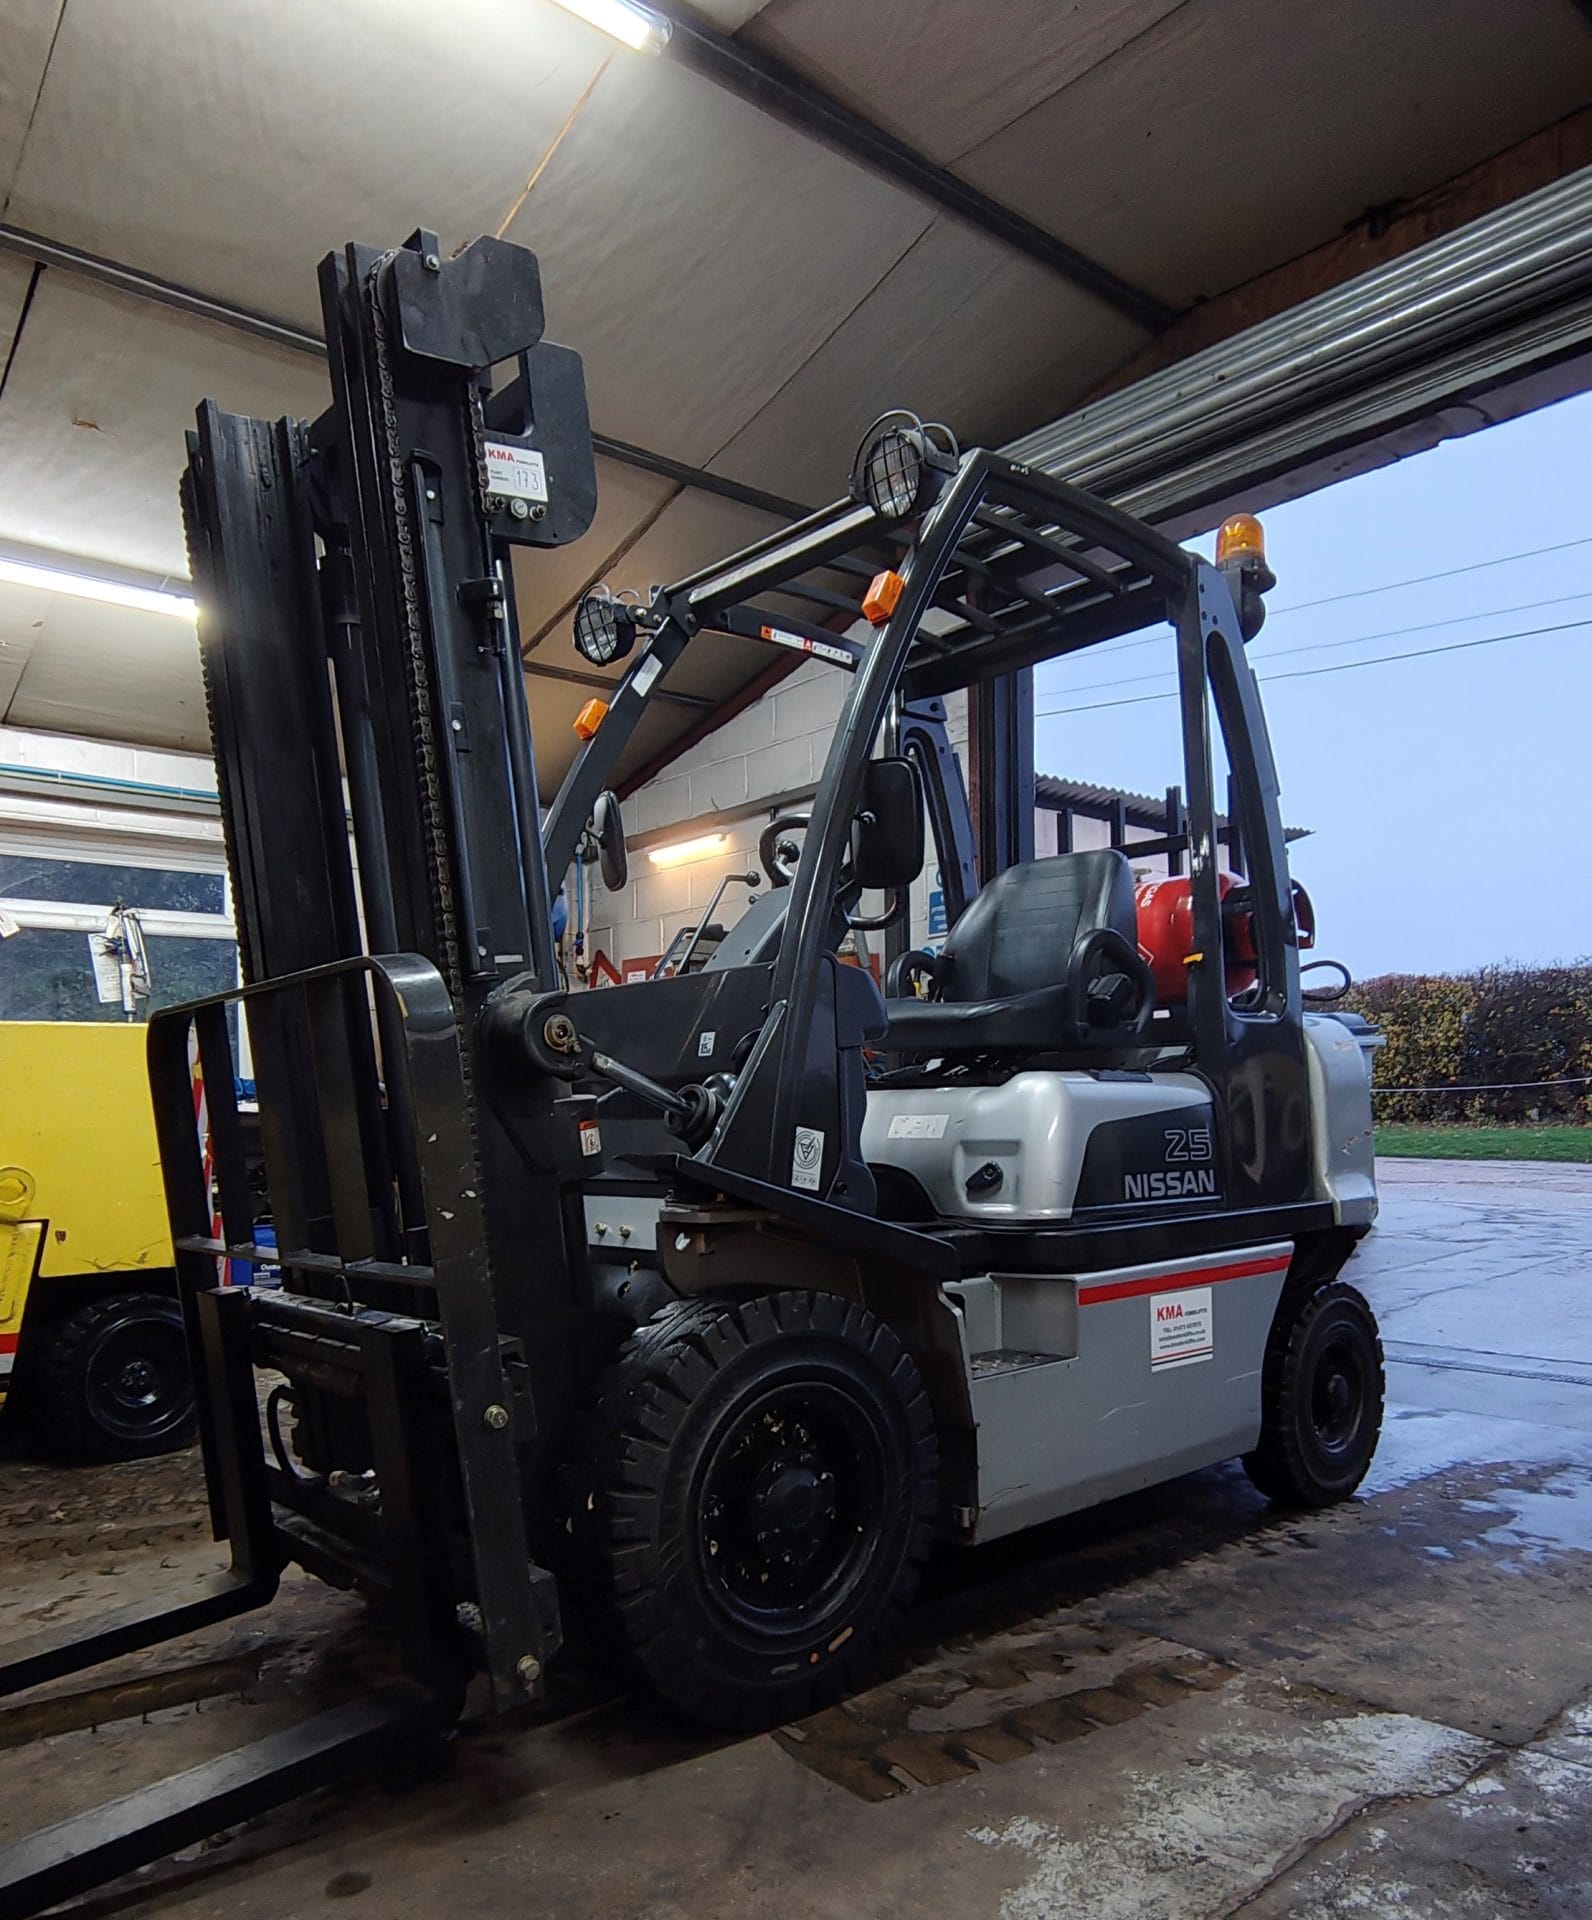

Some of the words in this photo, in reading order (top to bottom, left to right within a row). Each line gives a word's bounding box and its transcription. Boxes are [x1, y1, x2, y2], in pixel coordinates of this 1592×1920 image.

[487, 448, 515, 463] KMA
[516, 470, 539, 491] 173
[1164, 1128, 1212, 1162] 25
[1124, 1169, 1216, 1200] NISSAN
[1156, 1304, 1184, 1322] KMA
